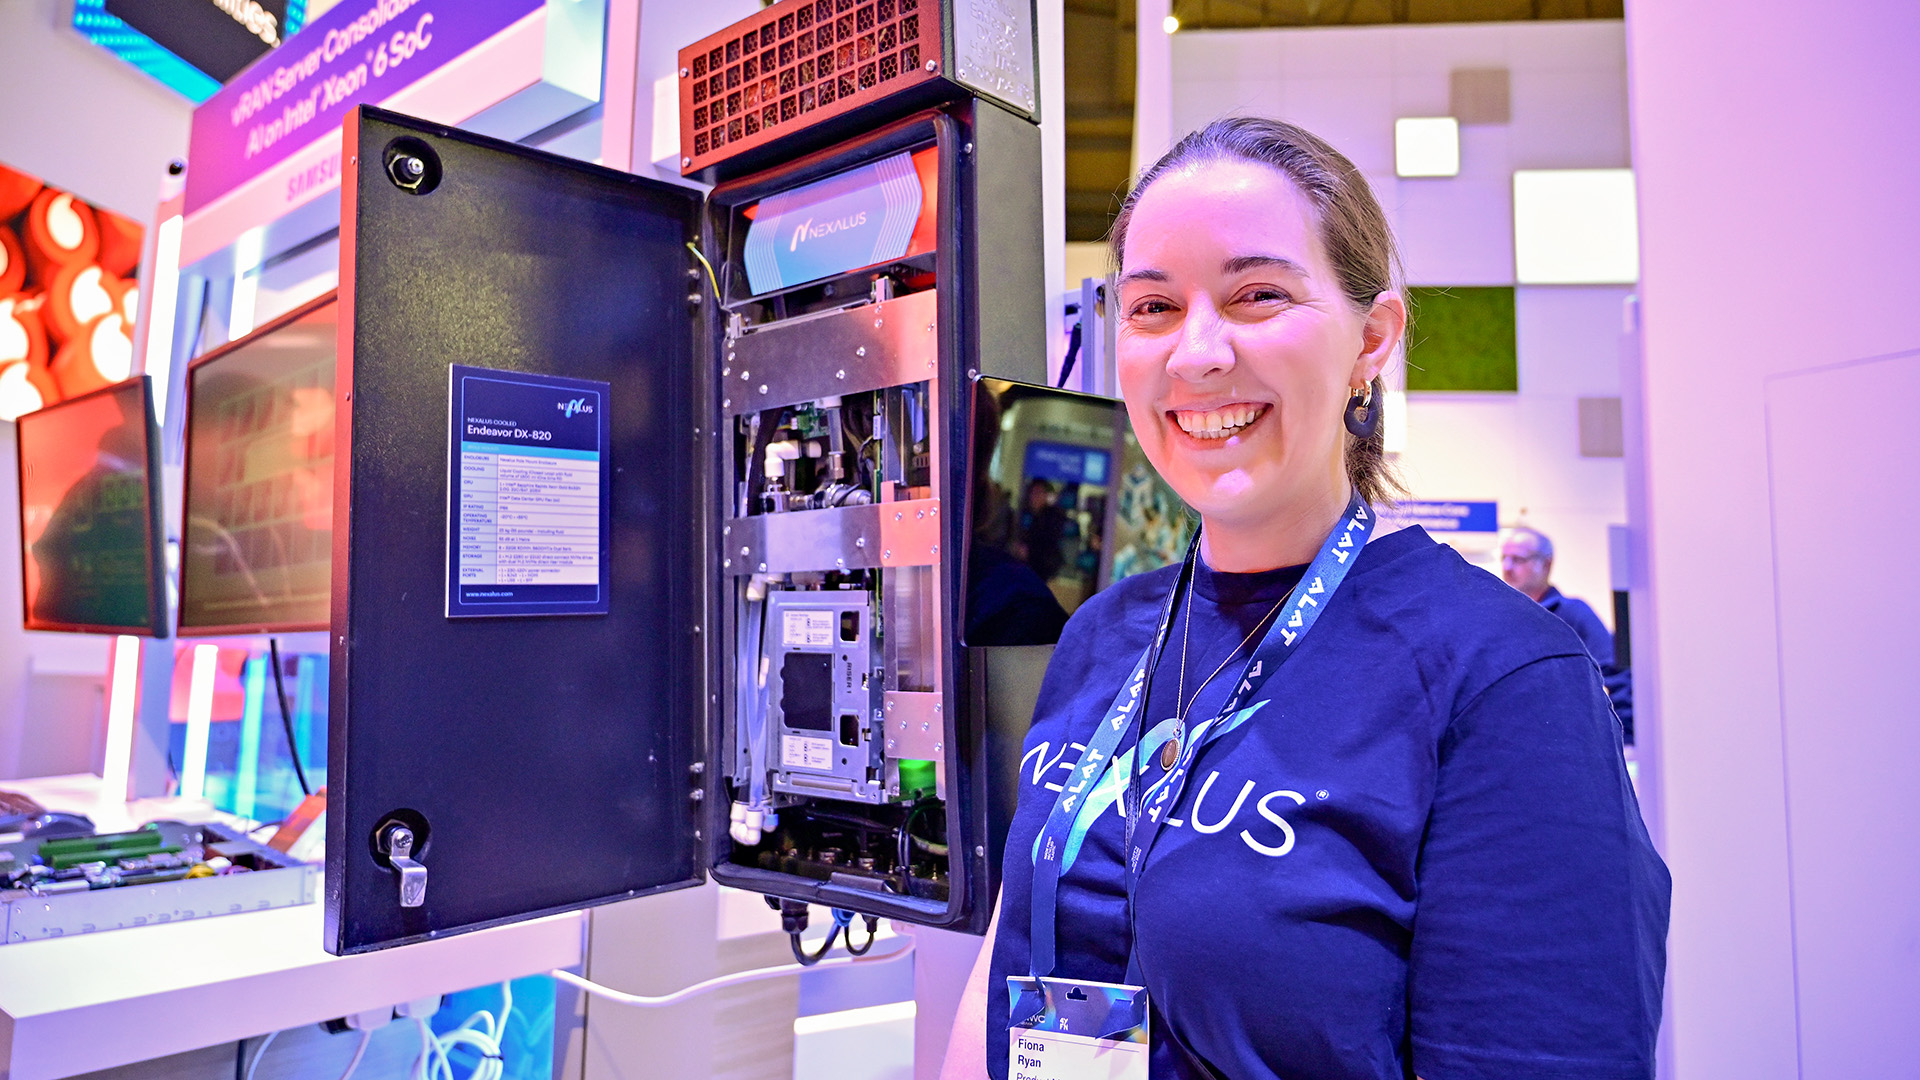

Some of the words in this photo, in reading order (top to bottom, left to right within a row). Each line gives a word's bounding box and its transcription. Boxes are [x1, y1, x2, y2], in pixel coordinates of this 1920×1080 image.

[373, 42, 388, 78] 6
[388, 12, 434, 68] SoC
[287, 152, 341, 202] SAMSU
[467, 416, 493, 425] NEXALUS
[493, 419, 517, 427] COOLED
[467, 425, 513, 438] Endeavor
[514, 429, 552, 441] DX-820
[1331, 505, 1369, 564] ALAT
[1280, 576, 1325, 647] ALAT
[1062, 748, 1104, 813] ALAT
[1026, 1014, 1046, 1024] WC
[1017, 1054, 1042, 1069] Ryan
[1018, 1038, 1045, 1052] Fiona
